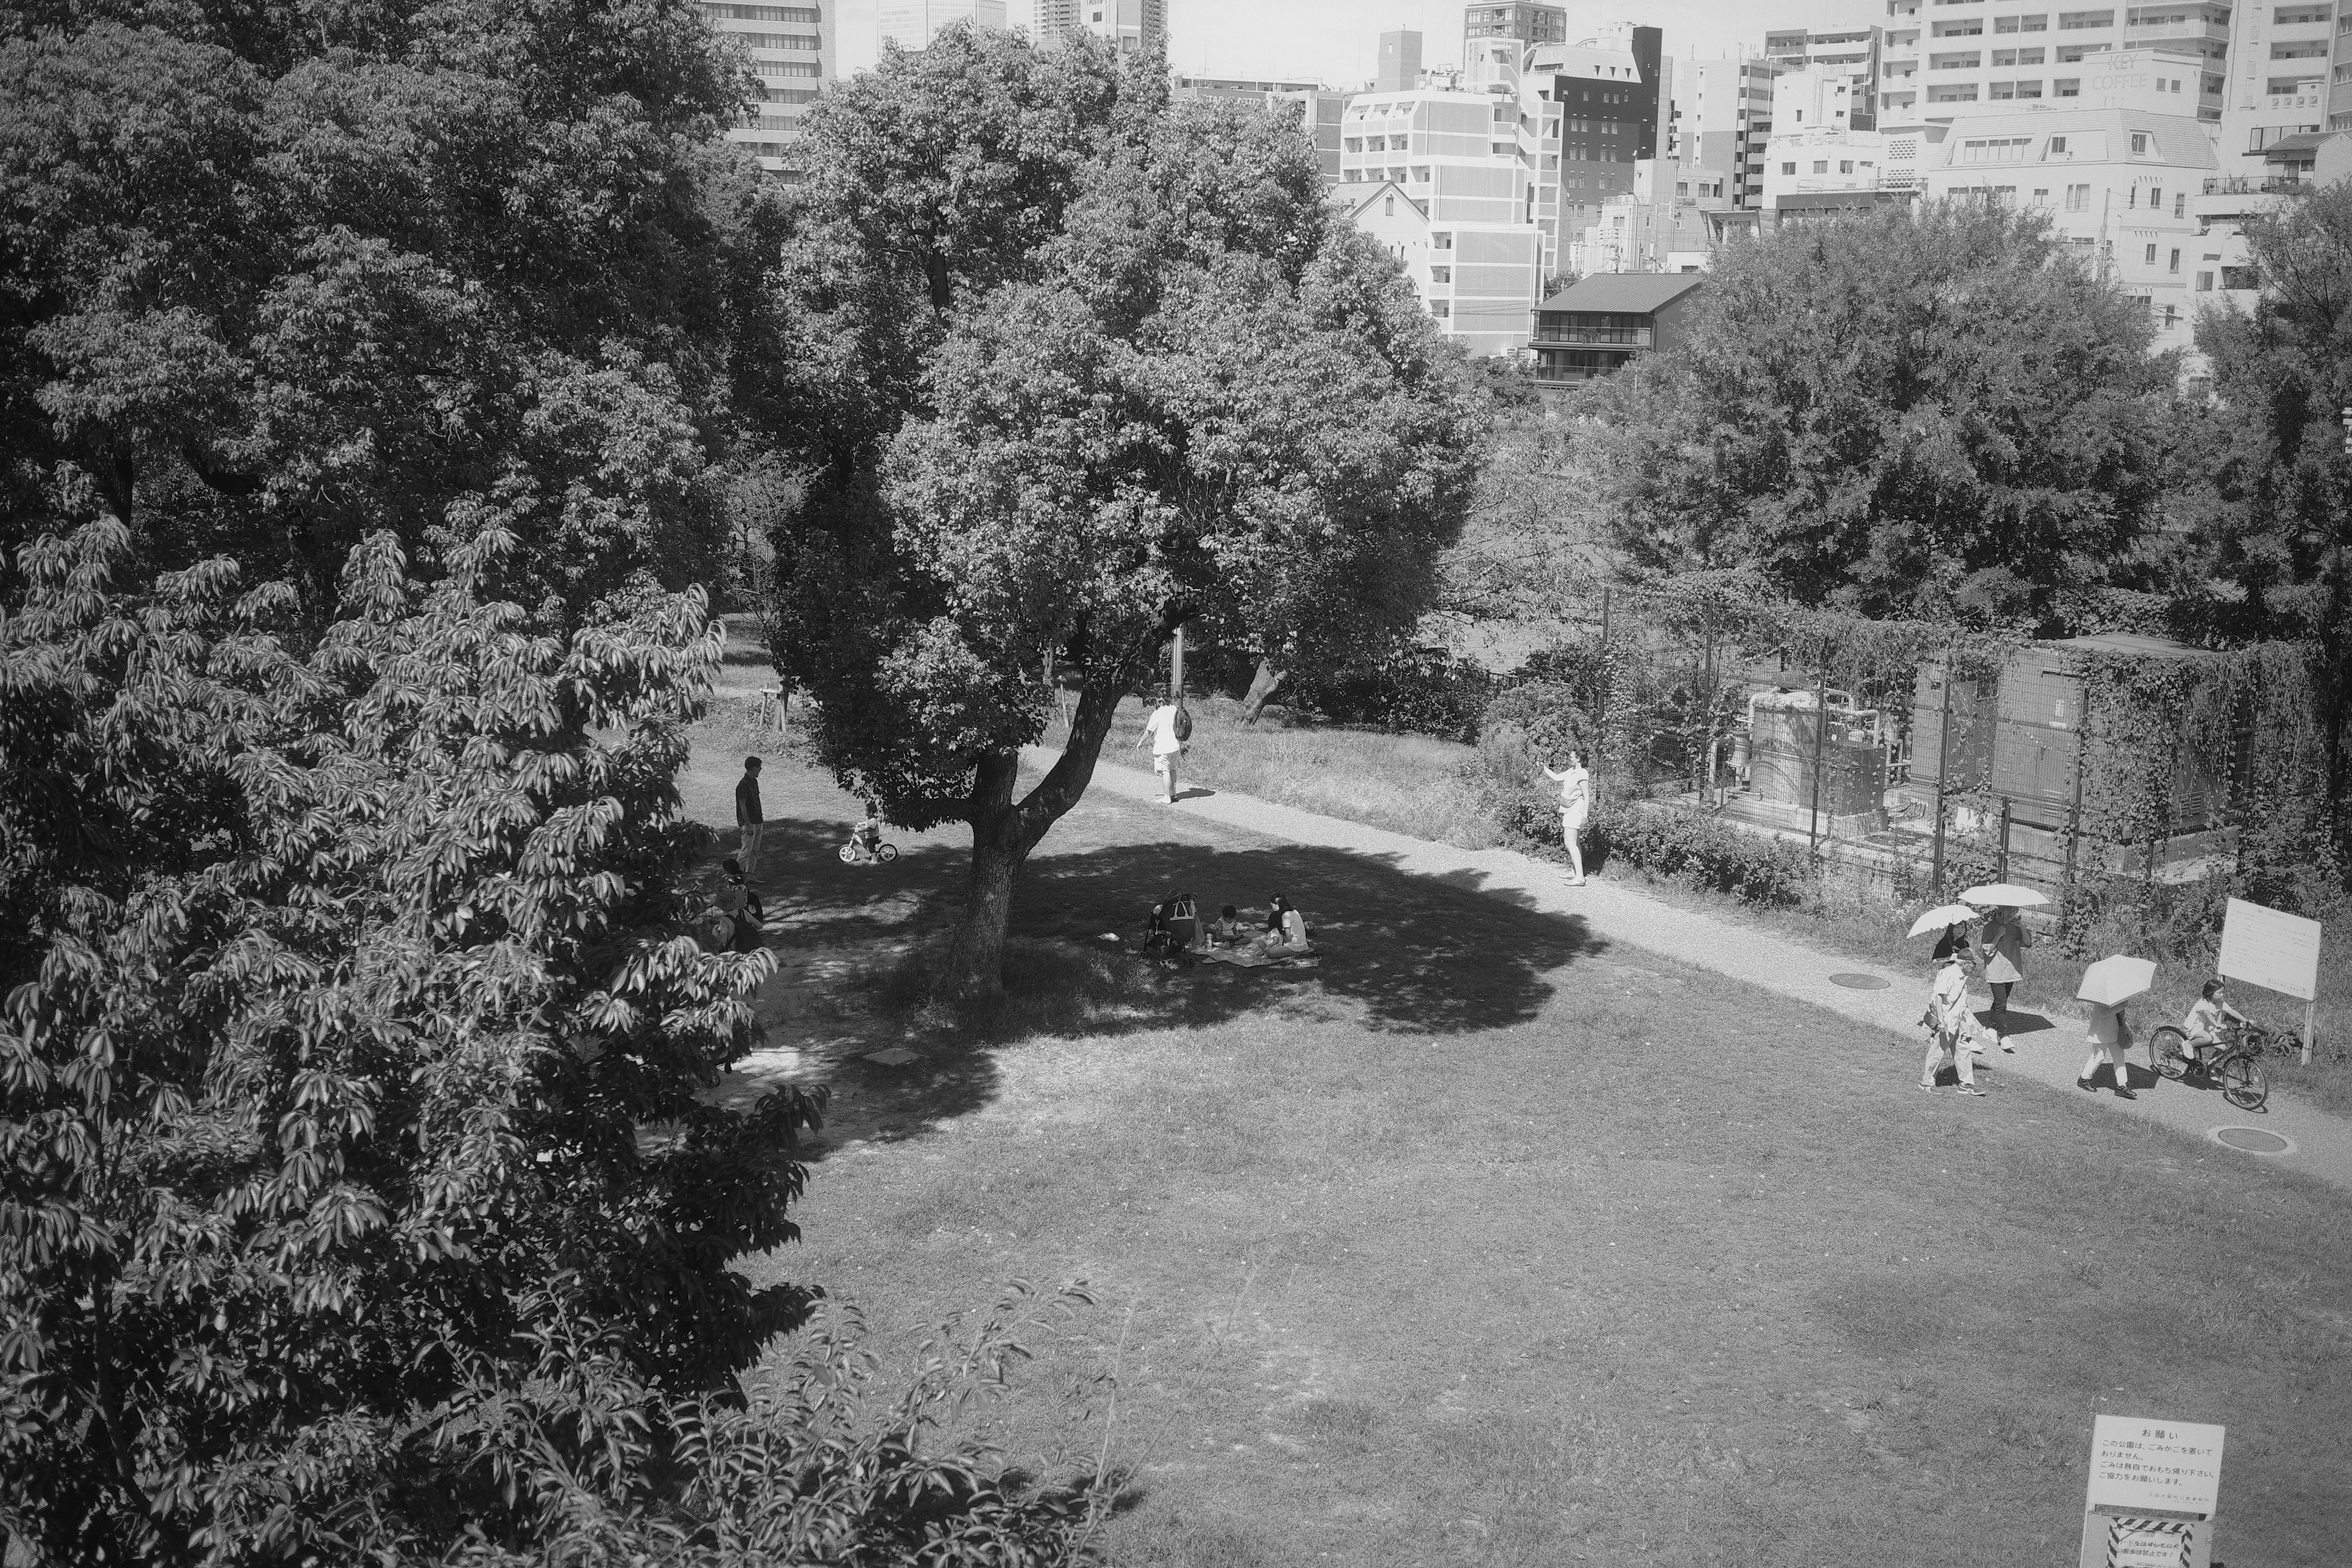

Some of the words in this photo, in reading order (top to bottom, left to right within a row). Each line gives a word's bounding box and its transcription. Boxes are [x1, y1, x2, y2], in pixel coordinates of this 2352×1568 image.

[2108, 53, 2138, 70] KEY
[2092, 72, 2147, 90] COFFEE
[2141, 1429, 2178, 1439] お願い
[2101, 1450, 2144, 1461] おりません。
[2102, 1439, 2212, 1456] この公園は、ごみかごを置いて
[2100, 1461, 2215, 1479] ごみは各自でおもち帰り下さい。
[2099, 1471, 2182, 1487] ご協力をお願いします。
